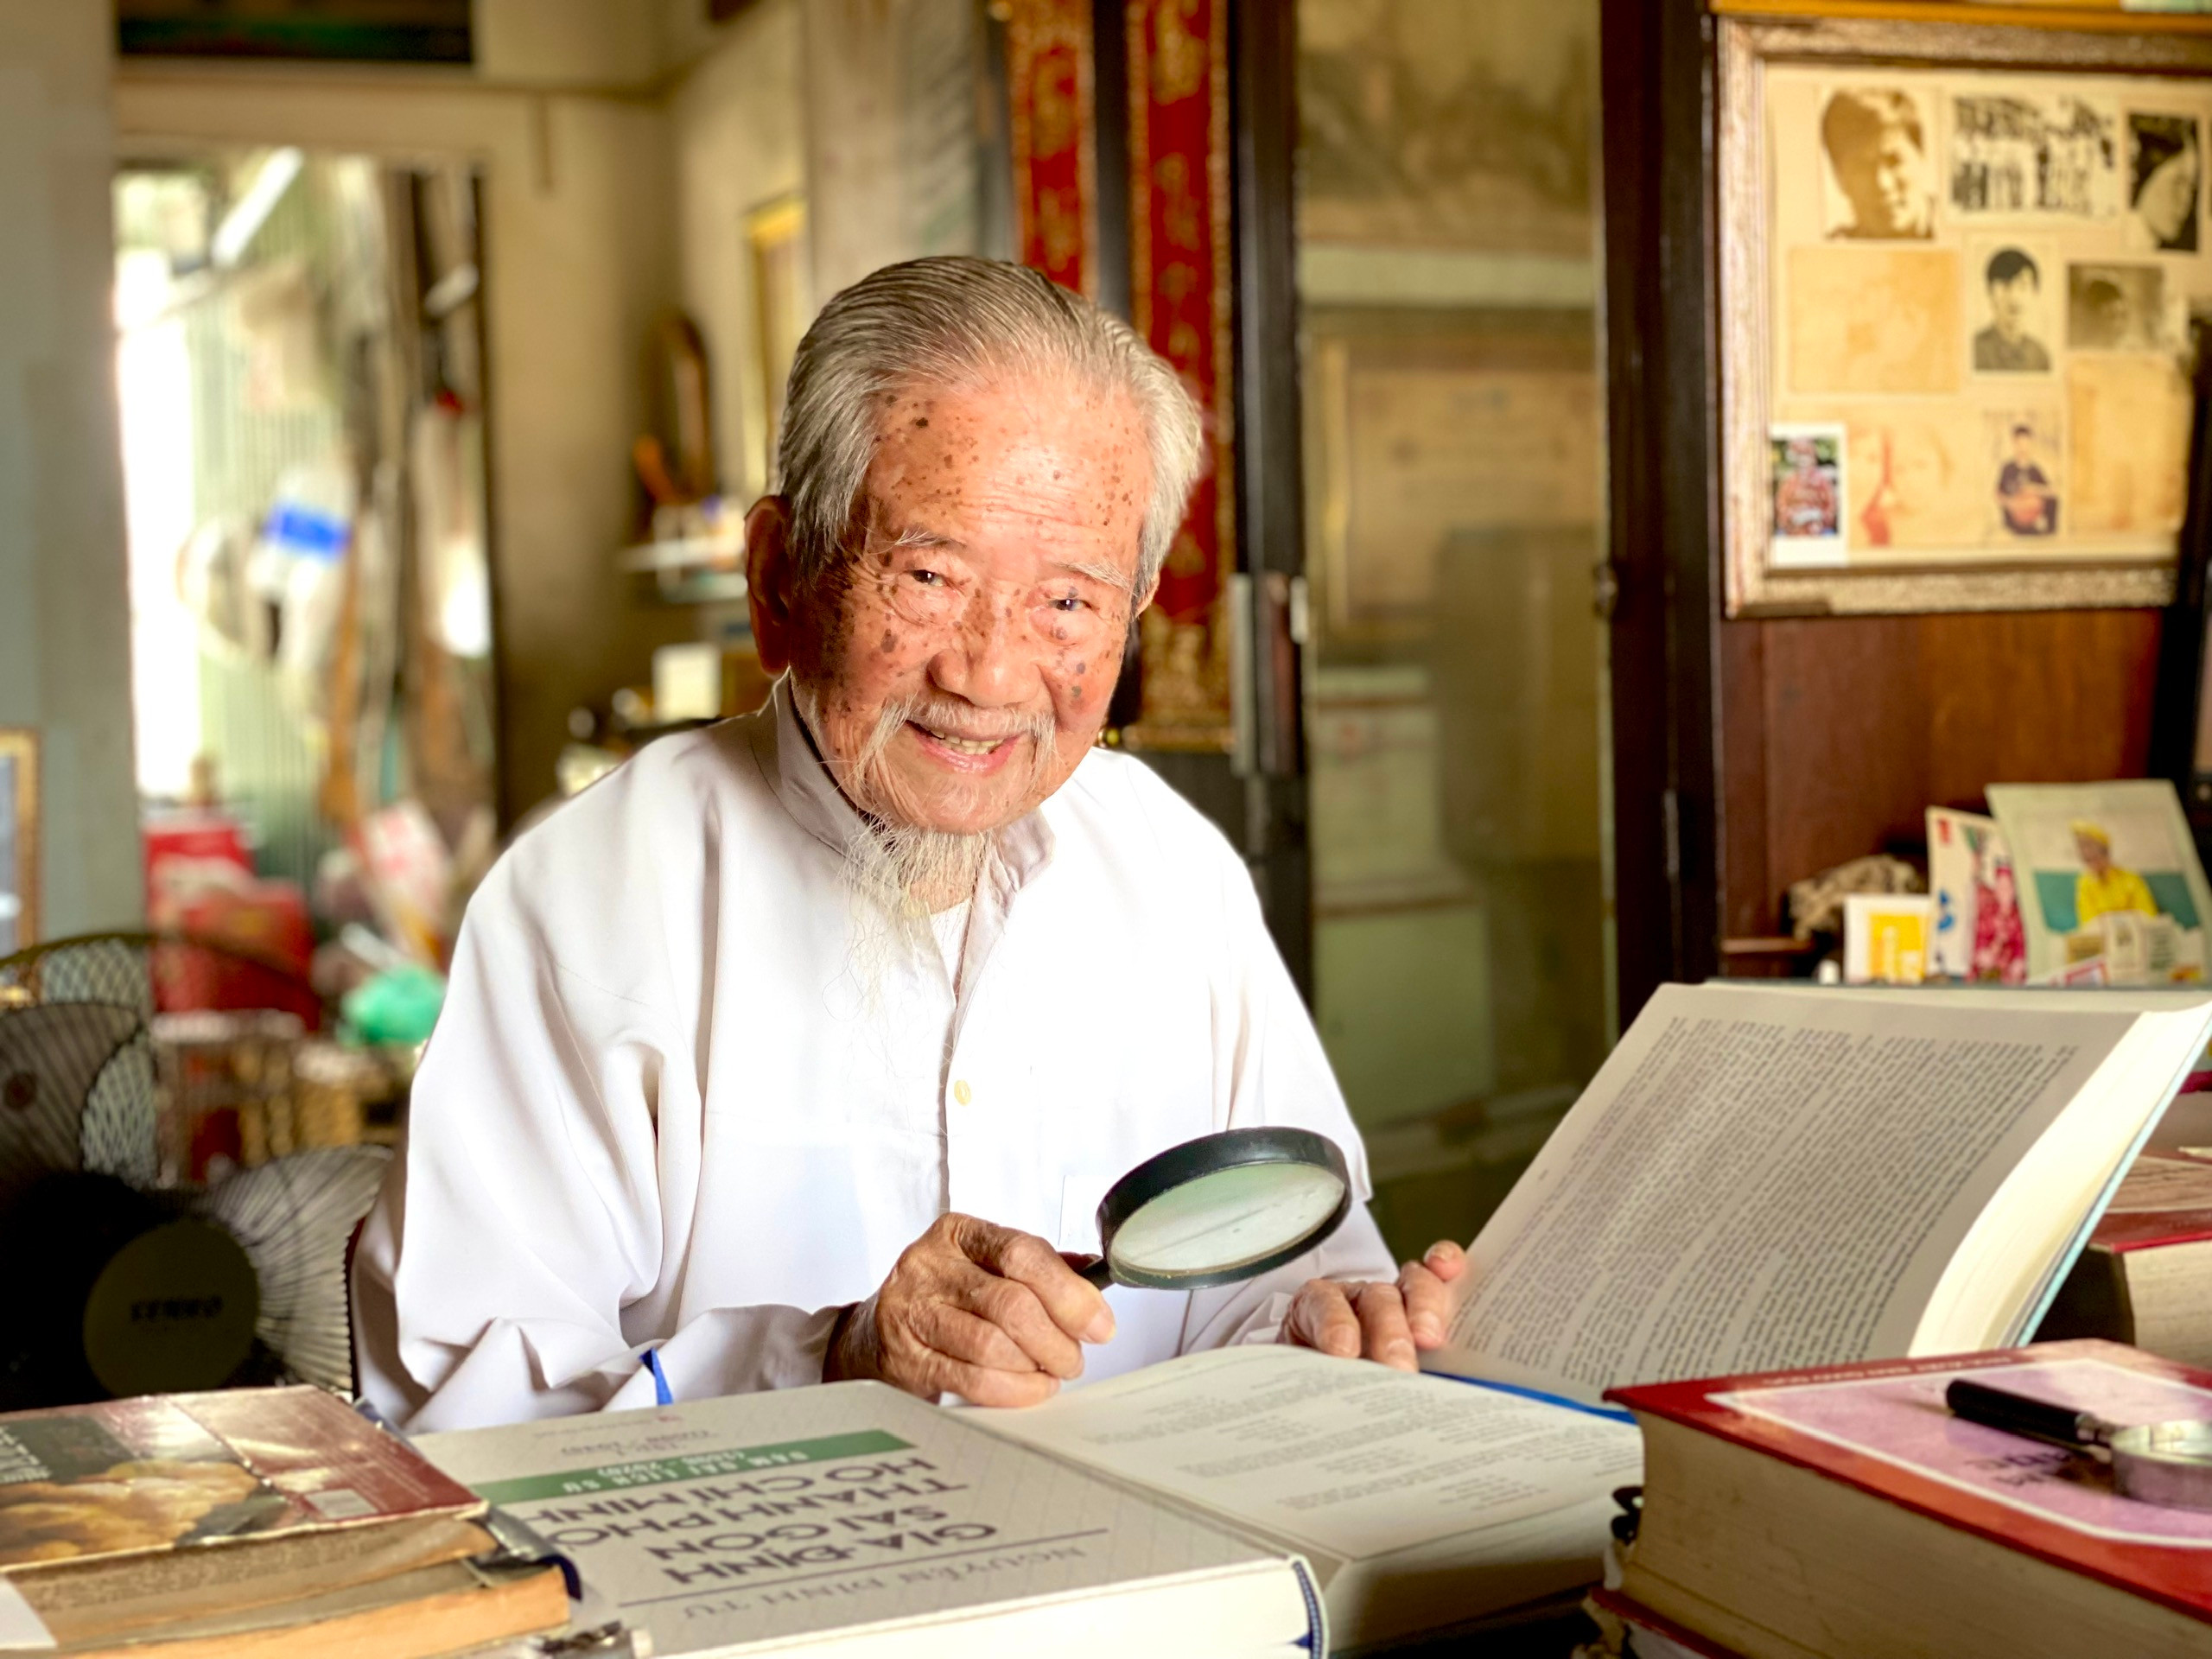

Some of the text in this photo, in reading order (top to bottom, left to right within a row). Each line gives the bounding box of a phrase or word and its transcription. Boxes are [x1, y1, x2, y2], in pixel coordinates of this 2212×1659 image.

[687, 1475, 815, 1507] CHÍ
[715, 1478, 969, 1522] THÀNH
[521, 1492, 690, 1524] MINH
[832, 1504, 949, 1533] SÀI
[662, 1522, 998, 1585] GIA ĐỊNH
